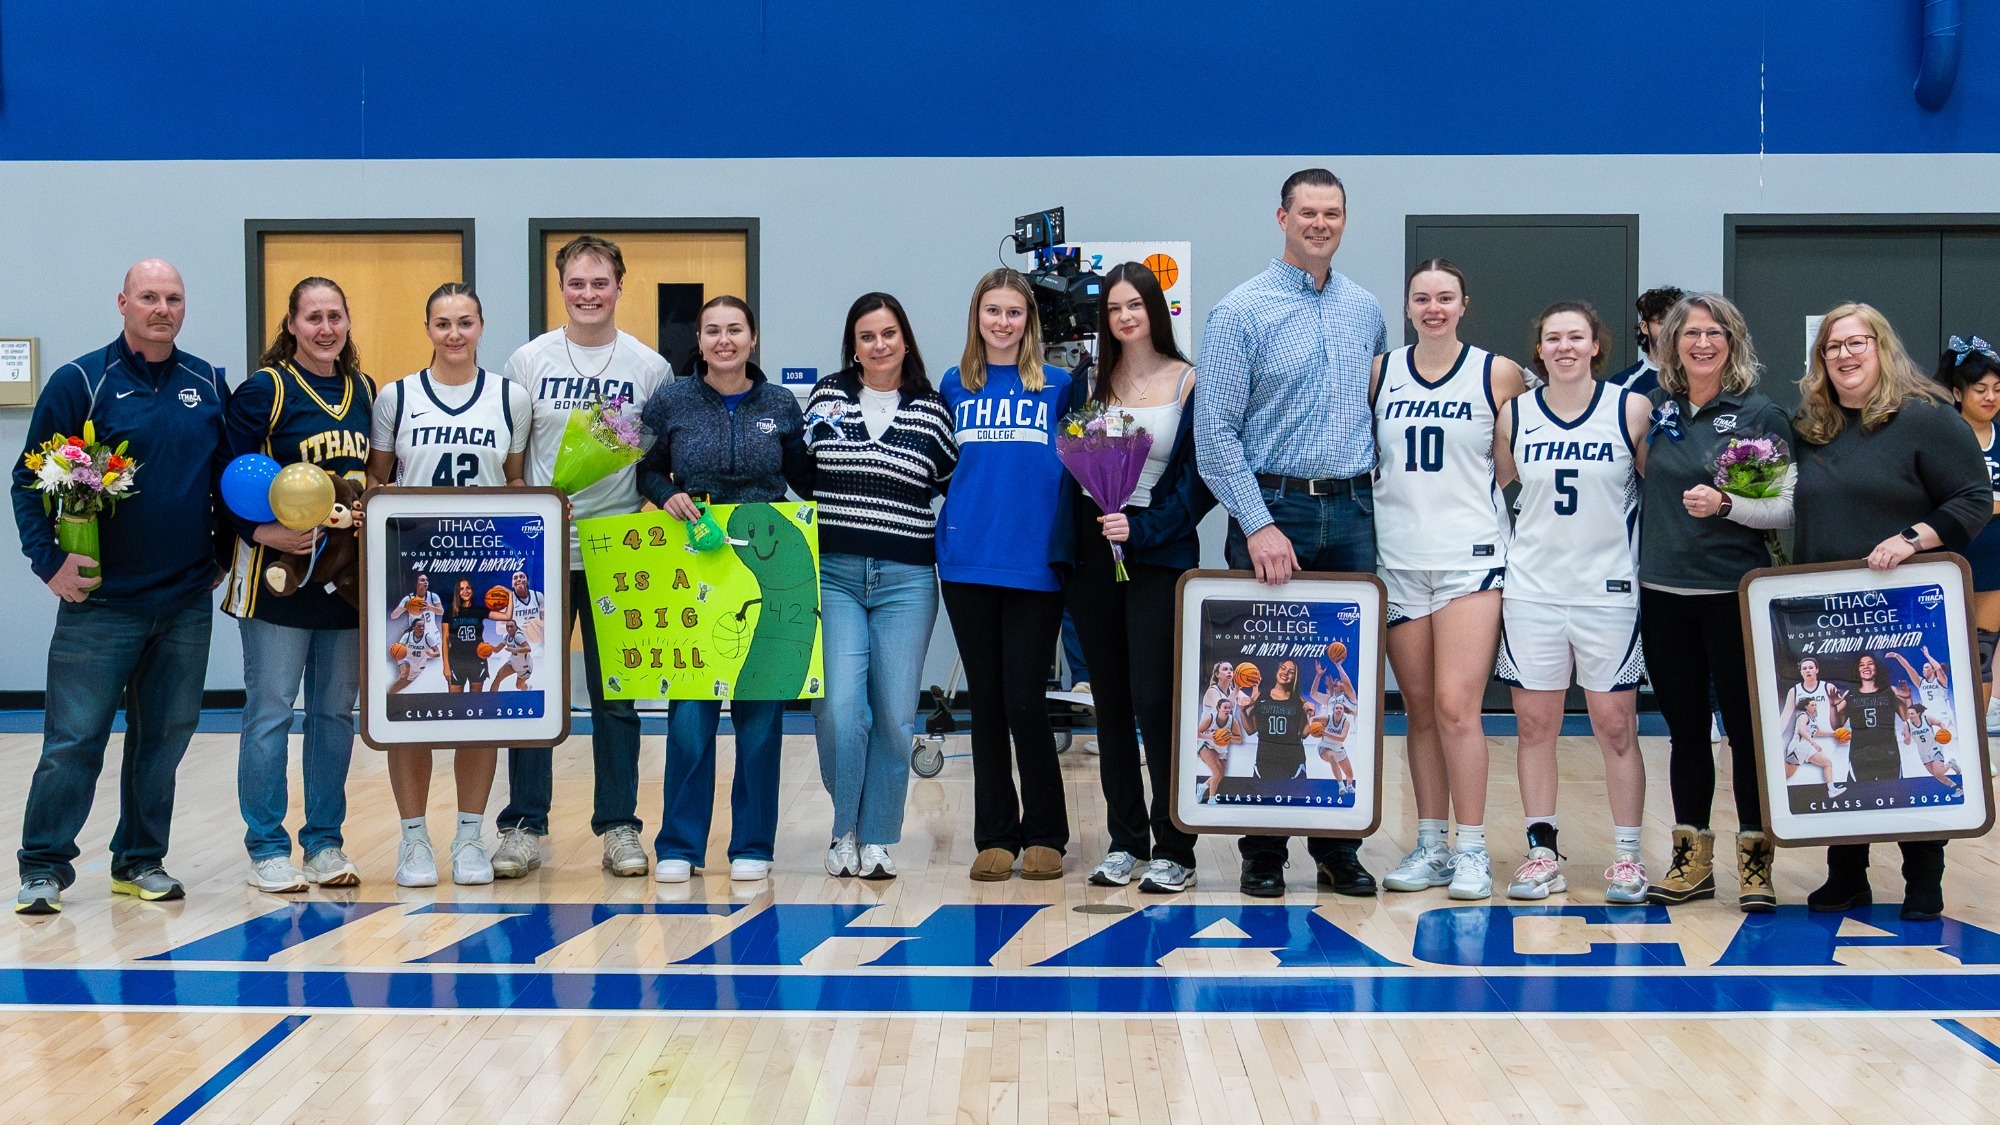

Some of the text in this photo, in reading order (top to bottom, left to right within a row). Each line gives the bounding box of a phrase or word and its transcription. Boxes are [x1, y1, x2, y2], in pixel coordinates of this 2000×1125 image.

[1170, 300, 1182, 316] 5
[786, 372, 804, 380] 103B
[178, 394, 202, 402] ITHACA
[538, 377, 634, 404] ITHACA
[1385, 400, 1472, 421] ITHACA
[756, 421, 777, 429] ITHACA
[1713, 417, 1737, 429] ITHACA
[411, 426, 497, 449] ITHACA
[977, 430, 1016, 440] COLLEGE
[1404, 425, 1445, 472] 10
[1523, 441, 1615, 464] ITHACA
[431, 452, 480, 487] 42
[1554, 468, 1579, 516] 5
[438, 519, 496, 532] ITHACA
[430, 535, 504, 548] COLLEGE
[477, 557, 526, 573] BARROWS
[613, 568, 690, 592] IS A
[1824, 592, 1888, 611] ITHACA
[1917, 594, 1944, 603] ITHACA
[624, 607, 698, 629] BIG
[769, 601, 803, 625] 42
[1252, 603, 1310, 618] ITHACA
[1817, 609, 1899, 629] COLLEGE
[457, 625, 476, 642] 42
[1244, 619, 1318, 634] COLLEGE
[1788, 622, 1937, 640] WOMEN'S BASKETBALL
[1278, 635, 1350, 643] BASKETBALL
[622, 647, 705, 669] DILL
[1255, 643, 1289, 657] AVERY
[1926, 691, 1934, 701] 5
[406, 708, 534, 718] CLASS OF 2026
[1864, 707, 1877, 728] 5
[1268, 715, 1287, 735] 10
[1919, 734, 1927, 743] 5
[1215, 793, 1343, 804] CLASS OF 2026
[1810, 794, 1951, 811] CLASS OF 2026
[132, 902, 2000, 968] ITHACA
